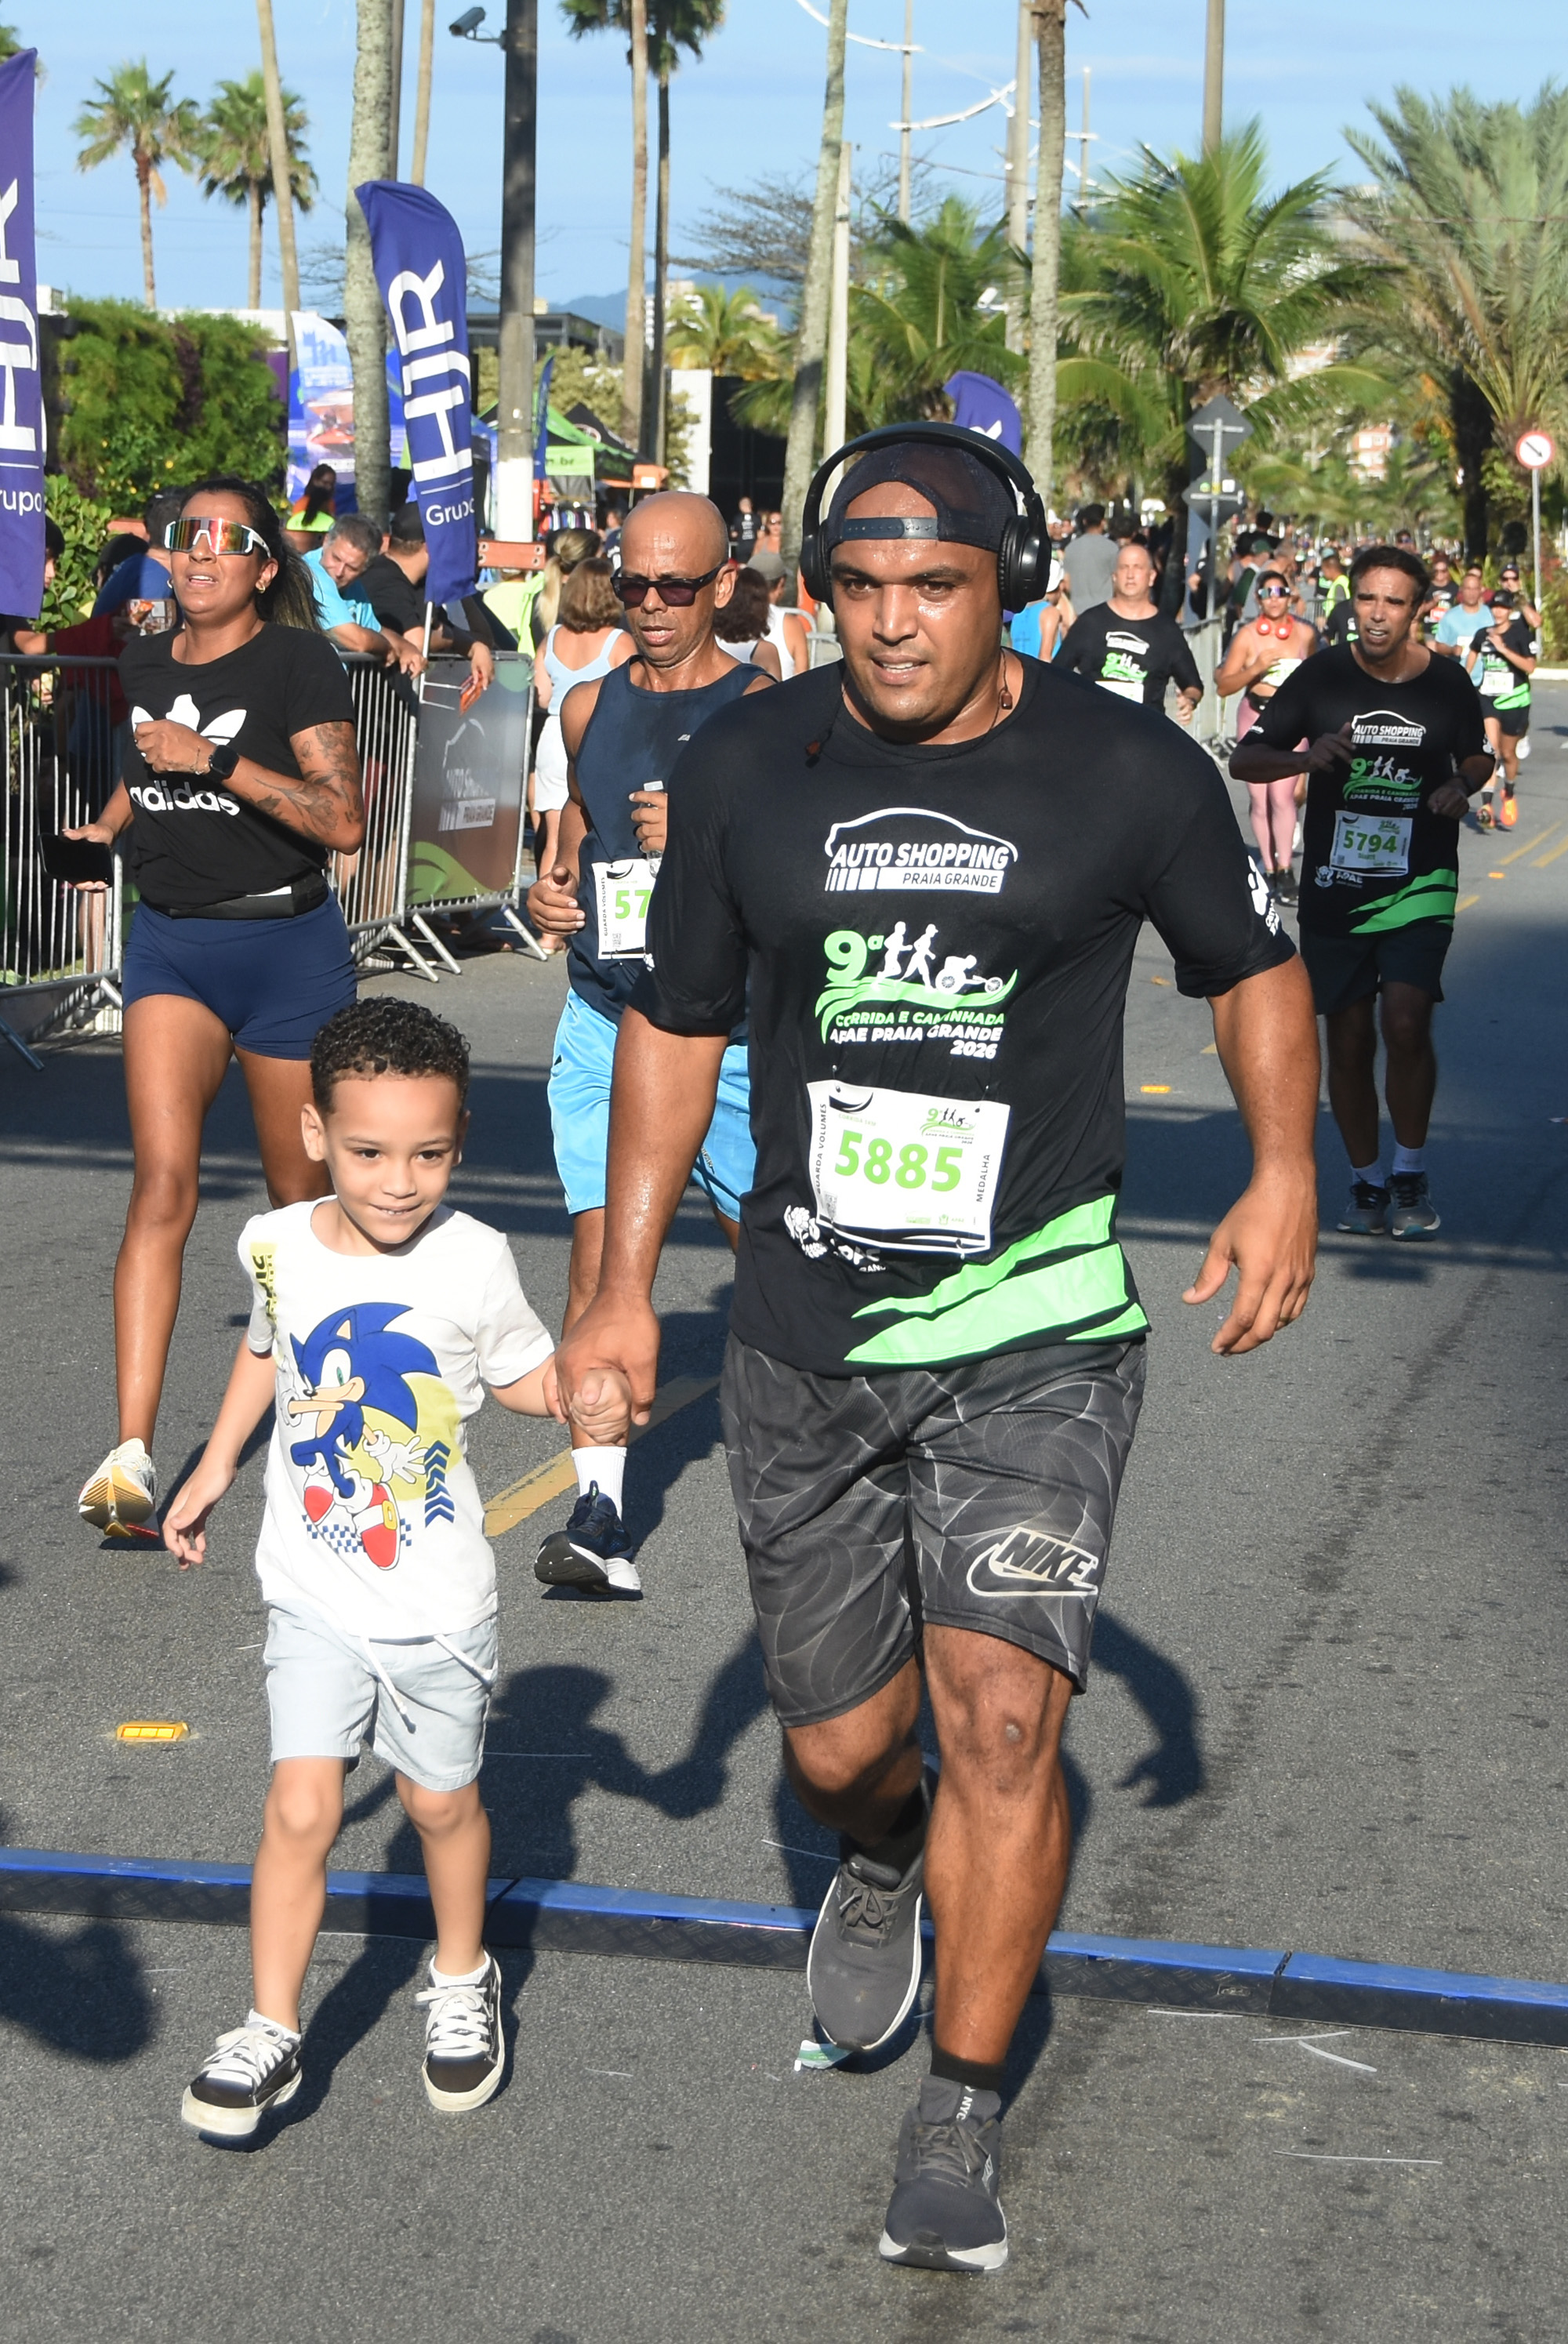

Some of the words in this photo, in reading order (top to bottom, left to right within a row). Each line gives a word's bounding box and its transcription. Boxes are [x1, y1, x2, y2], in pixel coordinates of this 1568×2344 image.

[388, 259, 472, 482] HJR
[0, 491, 42, 517] upo
[1354, 725, 1378, 735] AUTO
[1379, 726, 1423, 737] SHOPPING
[129, 780, 240, 816] adidas
[1343, 830, 1397, 853] 5794
[830, 843, 893, 868] AUTO
[895, 843, 1009, 869] SHOPPING
[902, 873, 941, 884] PRAIA
[945, 873, 997, 887] GRANDE
[836, 1012, 895, 1027] CORRIDA
[898, 1011, 909, 1023] E
[913, 1011, 1005, 1025] CAMINHADA
[829, 1028, 868, 1044] APAE
[871, 1027, 923, 1042] PRAIA
[927, 1024, 1003, 1041] GRANDE
[949, 1040, 997, 1059] 2026
[818, 1103, 827, 1149] VOLUMES
[834, 1129, 964, 1192] 5885
[976, 1154, 991, 1203] MEDALHA
[994, 1530, 1093, 1583] NIKE
[956, 2095, 973, 2121] NYC
